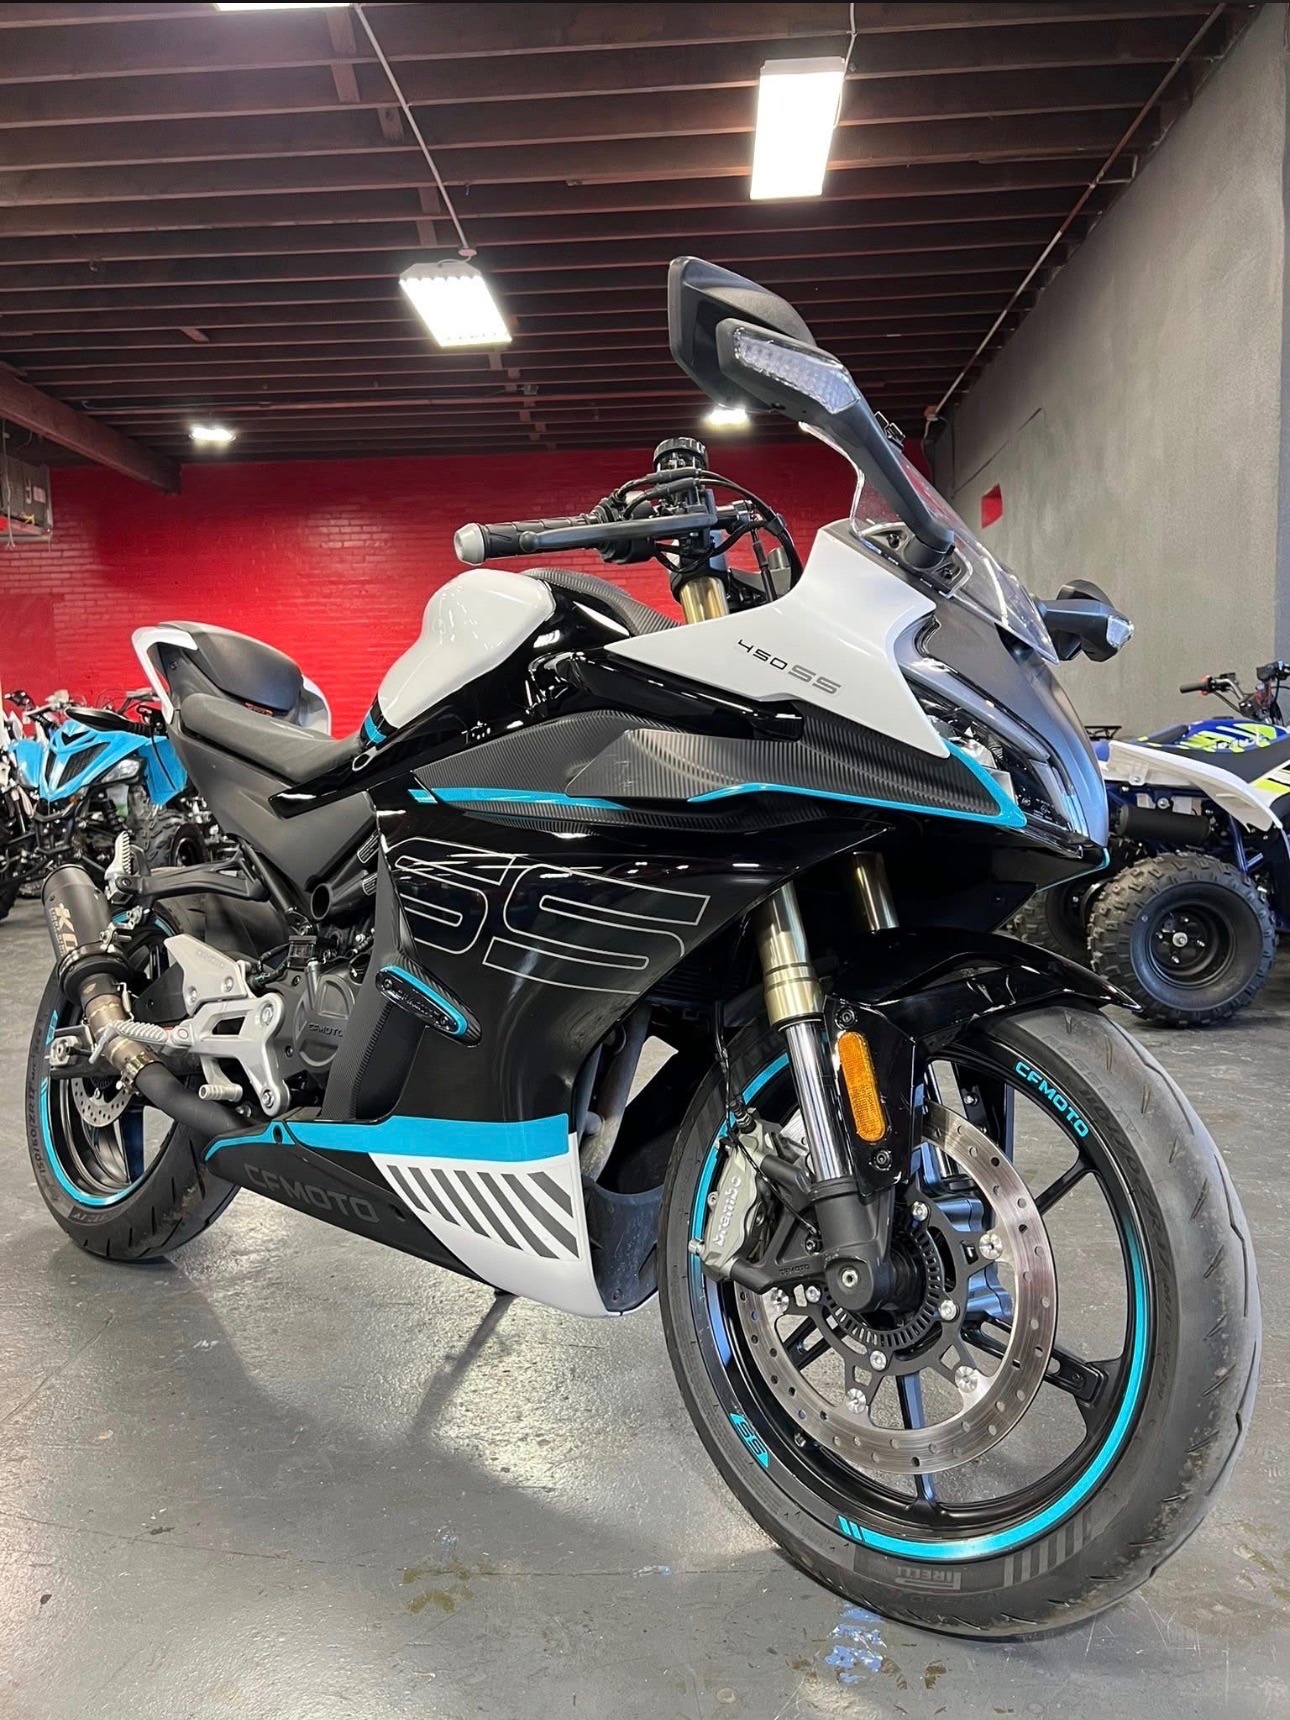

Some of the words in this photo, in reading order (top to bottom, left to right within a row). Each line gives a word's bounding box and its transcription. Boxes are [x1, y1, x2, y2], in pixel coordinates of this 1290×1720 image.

[1015, 1061, 1089, 1137] CFMOTO
[244, 1162, 380, 1224] CFMOTO
[713, 1175, 742, 1247] brembo
[736, 1421, 766, 1455] SS
[895, 1565, 962, 1591] PIRELLI
